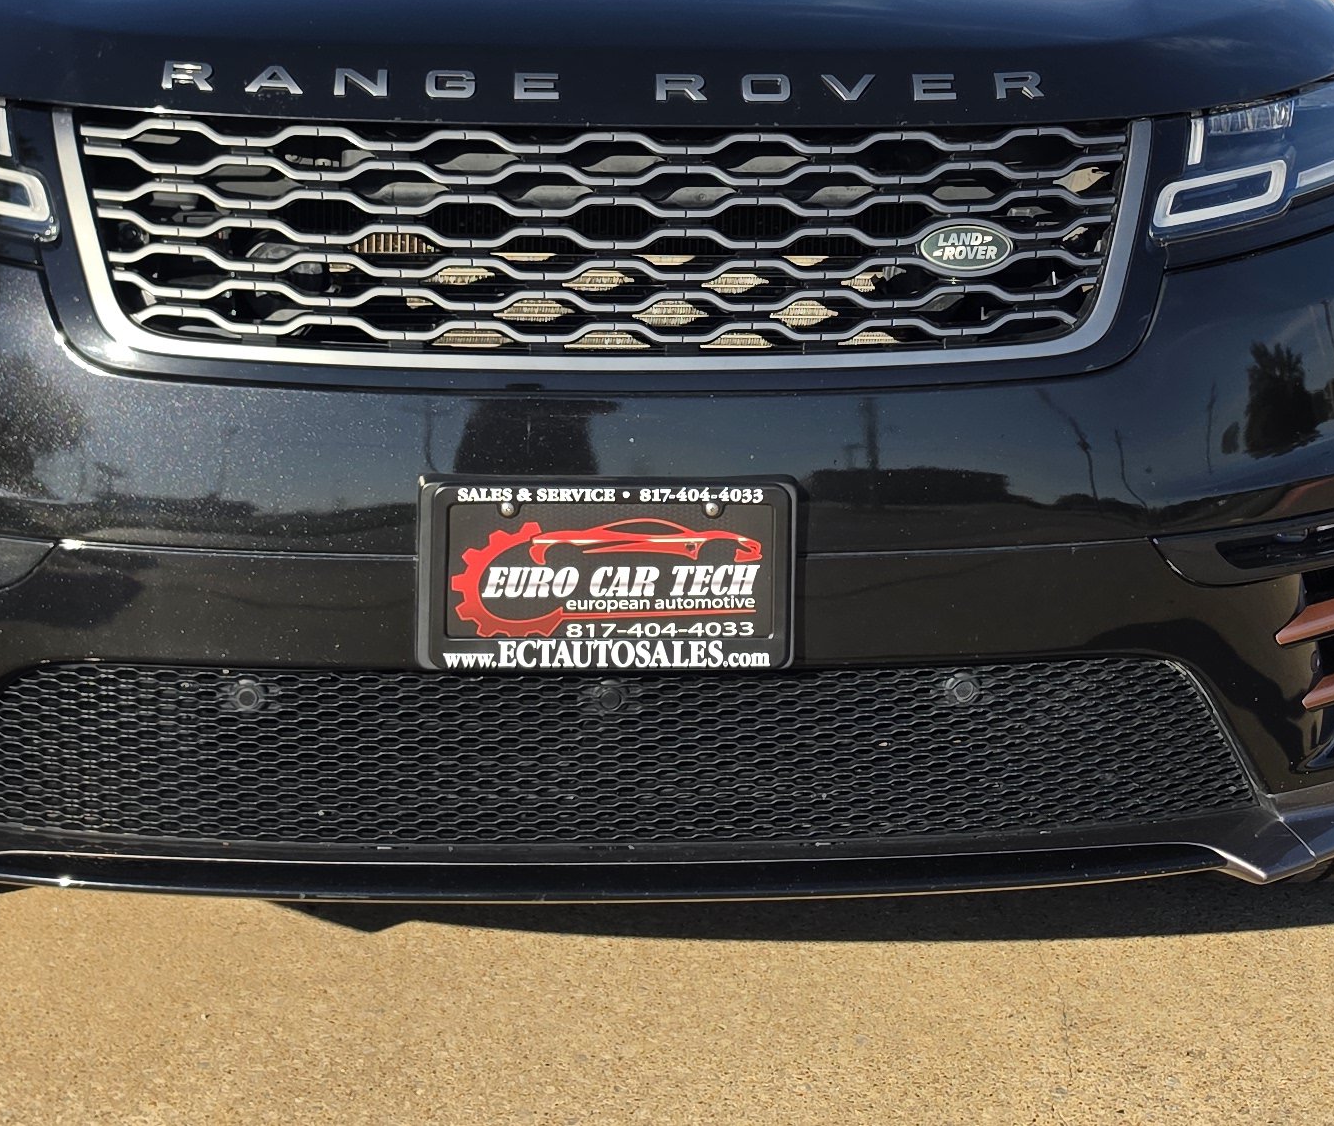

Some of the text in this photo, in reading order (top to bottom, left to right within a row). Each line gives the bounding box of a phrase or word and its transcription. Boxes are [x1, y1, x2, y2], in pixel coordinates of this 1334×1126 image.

[160, 60, 1045, 102] RANGE ROVER
[937, 232, 983, 247] LAND
[942, 245, 998, 260] ROVER
[457, 488, 764, 504] SALES & SERVICE 817-404-4033
[482, 564, 761, 598] EURO CAR TECH
[566, 595, 756, 613] european automotive
[566, 622, 755, 639] 817-404-4033
[443, 640, 771, 669] www.ECTAUTOSALES.com
